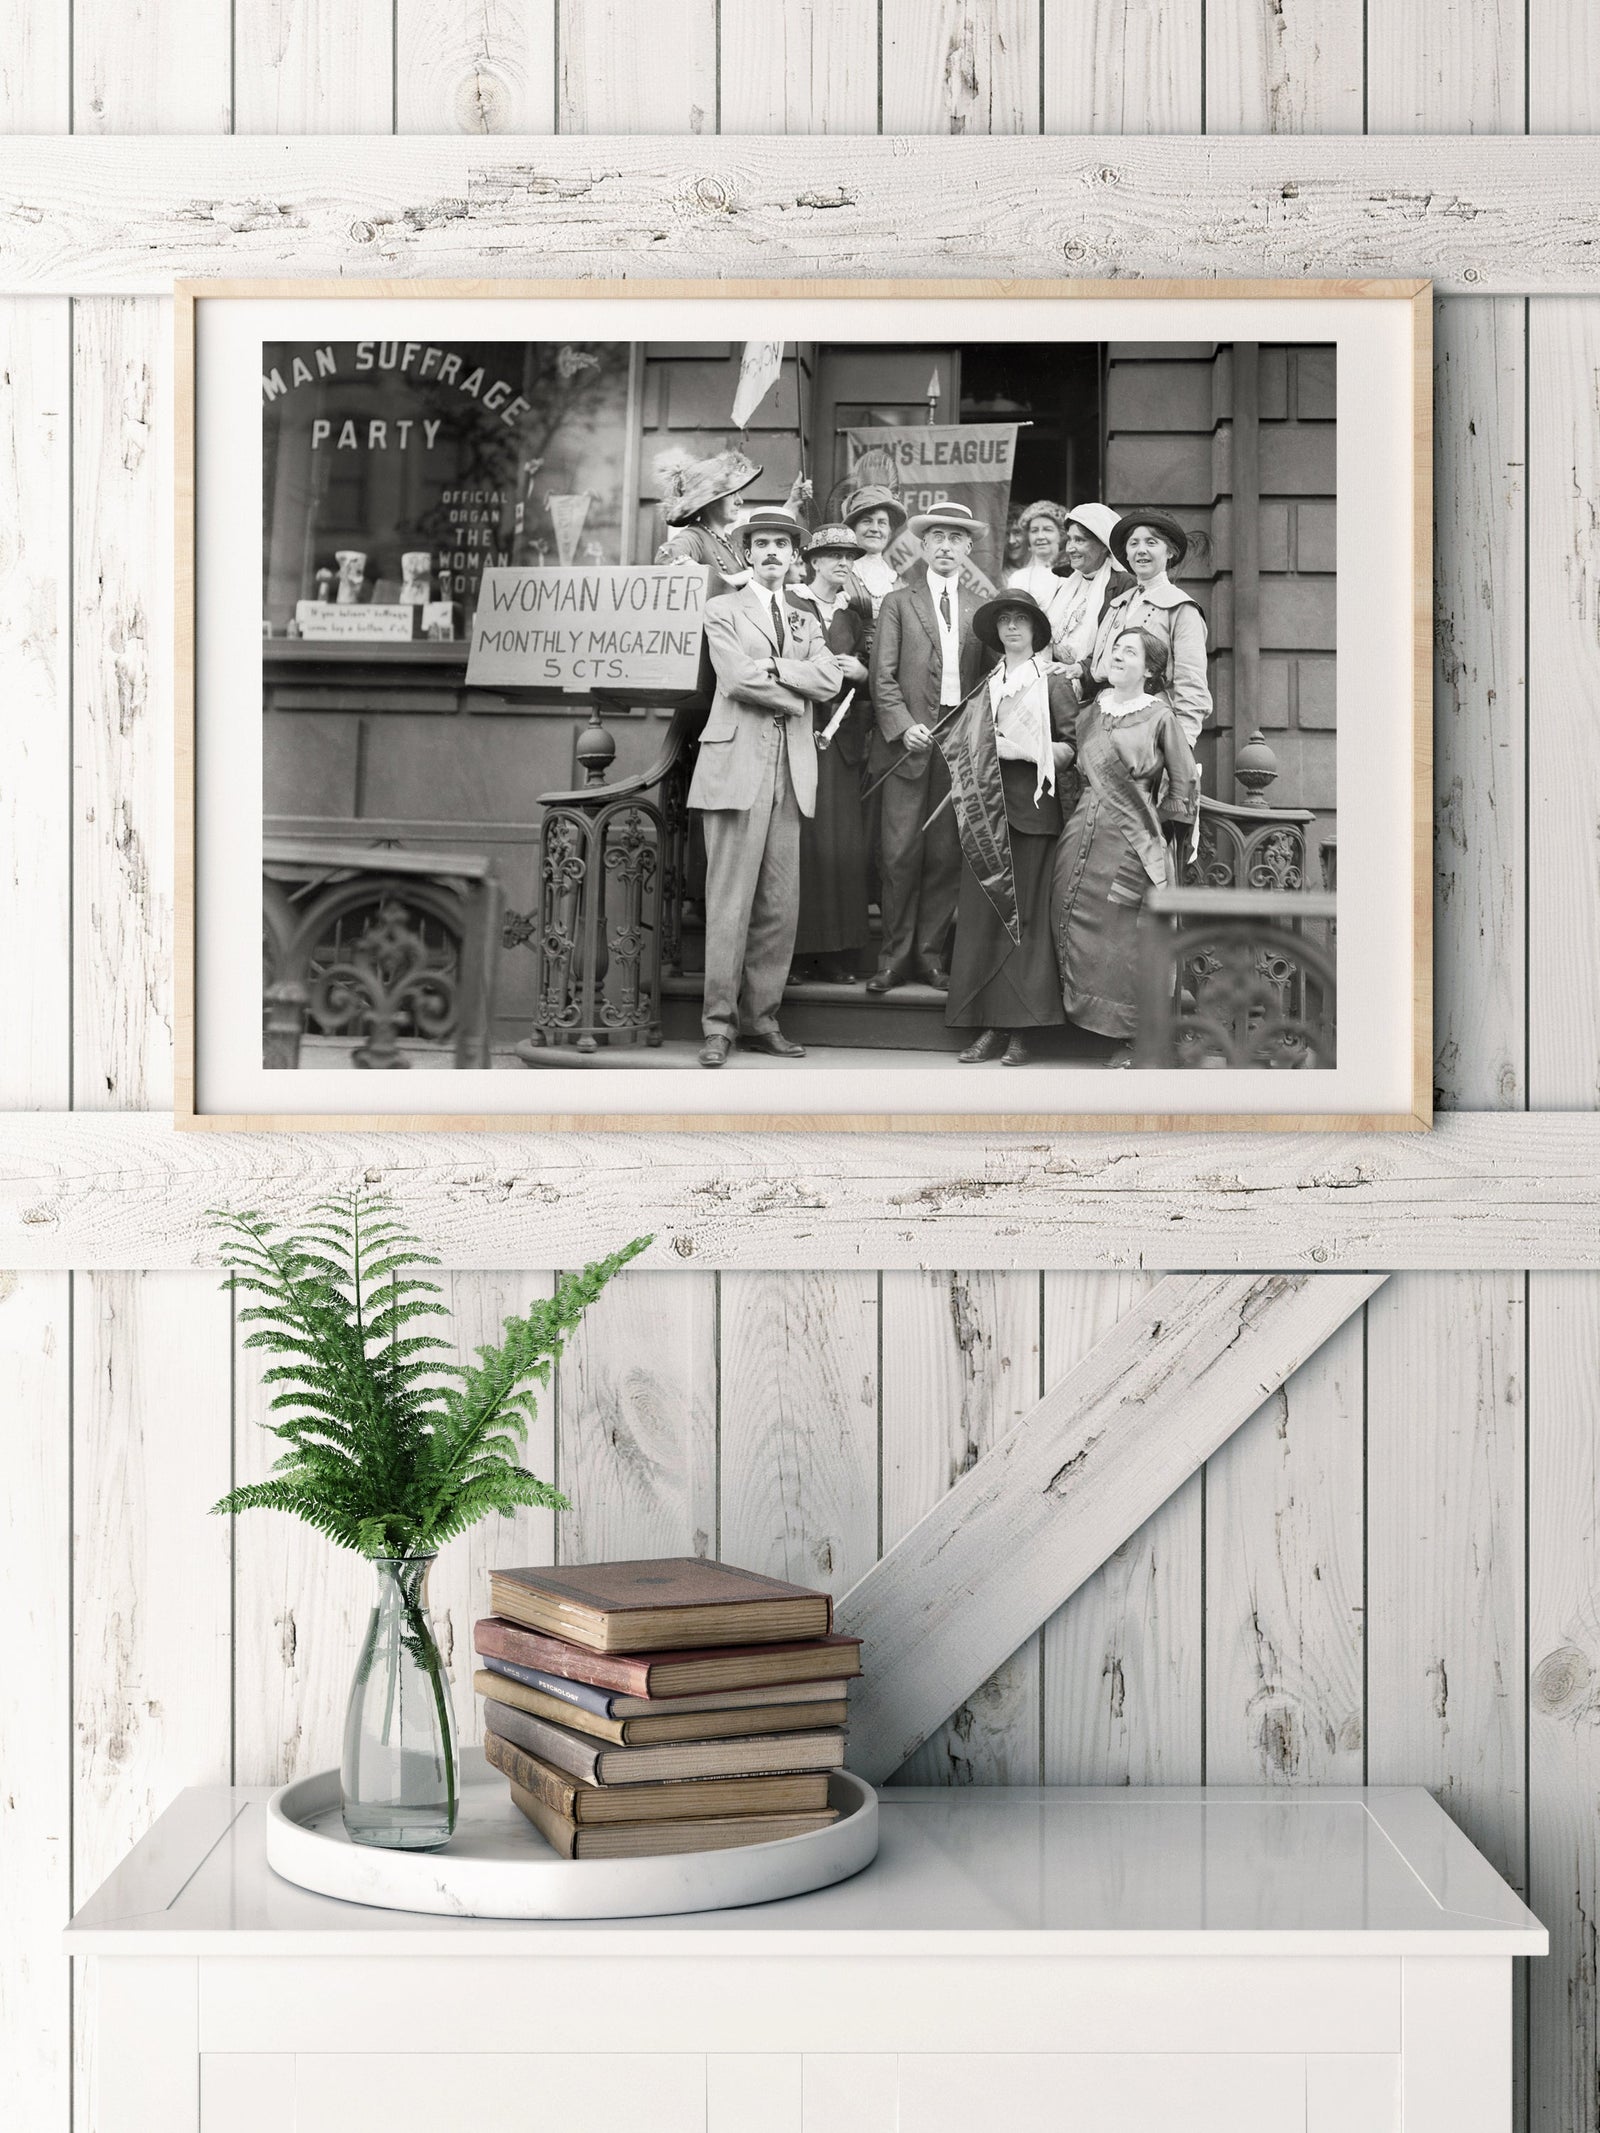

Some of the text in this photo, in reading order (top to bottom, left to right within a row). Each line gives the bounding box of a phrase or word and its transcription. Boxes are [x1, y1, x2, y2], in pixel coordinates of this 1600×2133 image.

[355, 342, 531, 427] SUFFRAGE
[311, 419, 441, 450] PARTY
[920, 439, 1009, 466] LEAGUE
[442, 490, 508, 504] OFFICIAL
[449, 509, 500, 523] ORGAN
[455, 528, 492, 547] THE
[439, 551, 509, 569] WOMAN
[492, 576, 704, 612] WOMAN VOTER
[478, 630, 697, 656] MONTHLY MAGAZINE
[543, 658, 629, 678] 5 CTS.
[963, 792, 985, 825] FOR
[974, 824, 1001, 873] WOMEN
